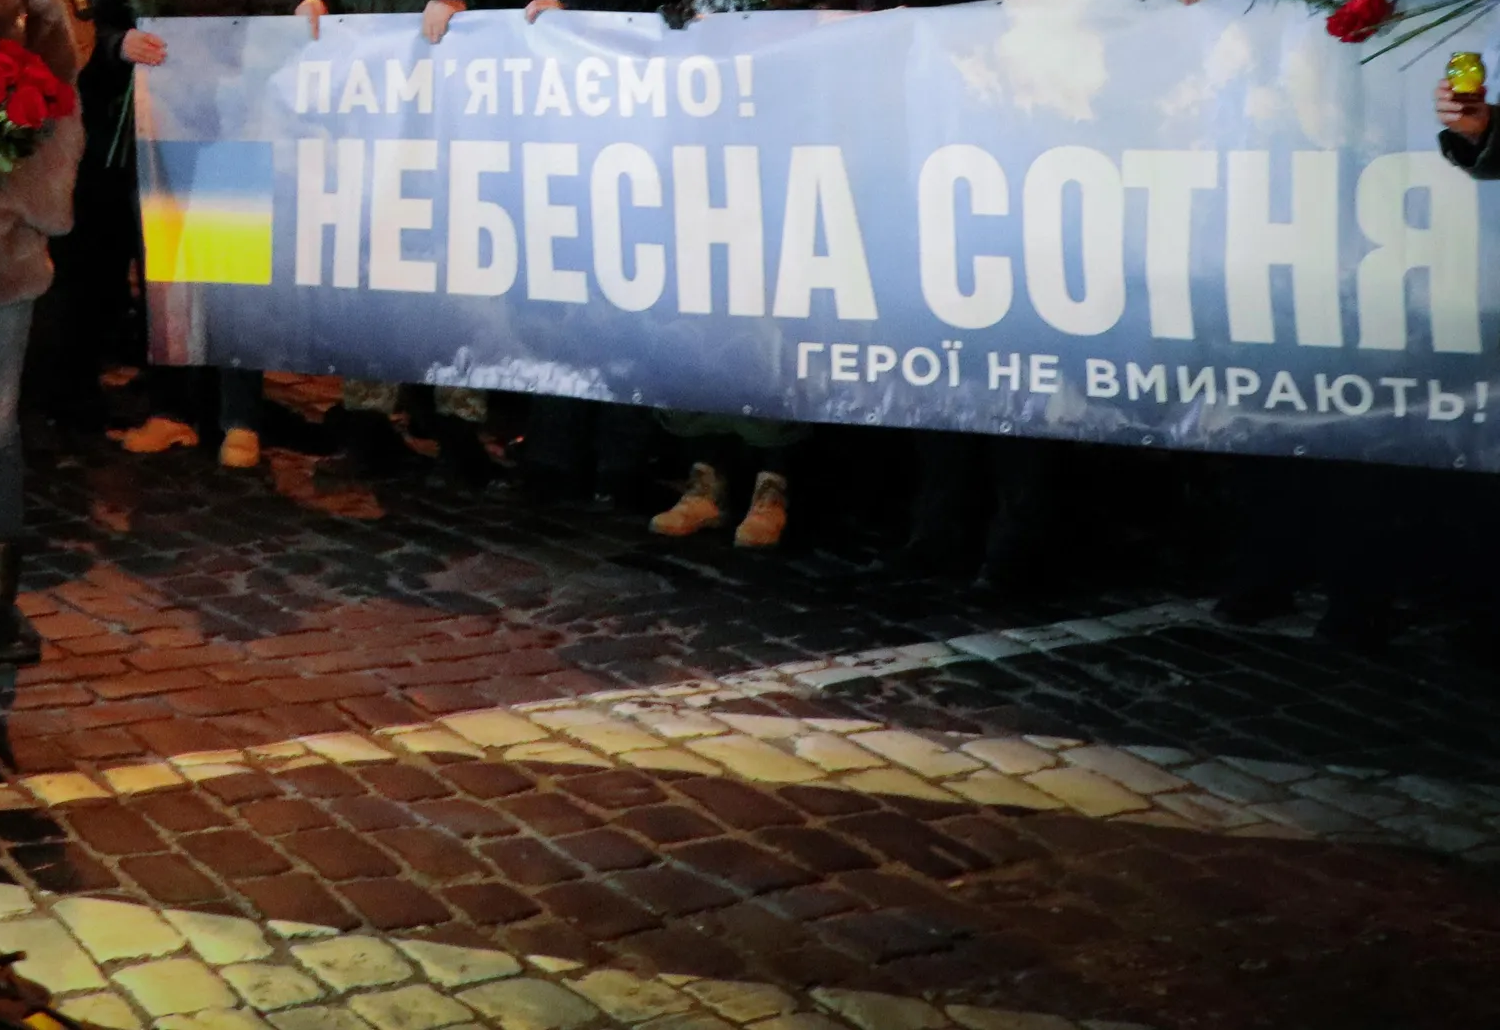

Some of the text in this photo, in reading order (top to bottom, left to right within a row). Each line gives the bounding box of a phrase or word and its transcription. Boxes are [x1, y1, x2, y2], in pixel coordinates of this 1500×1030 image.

[295, 55, 756, 118] ПАМ'ЯТАЄМО!
[295, 138, 1483, 354] НЕБЕСНА СОТНЯ
[797, 340, 1489, 423] ГЕРОЇ НЕ ВМИРАЮТЬ!
